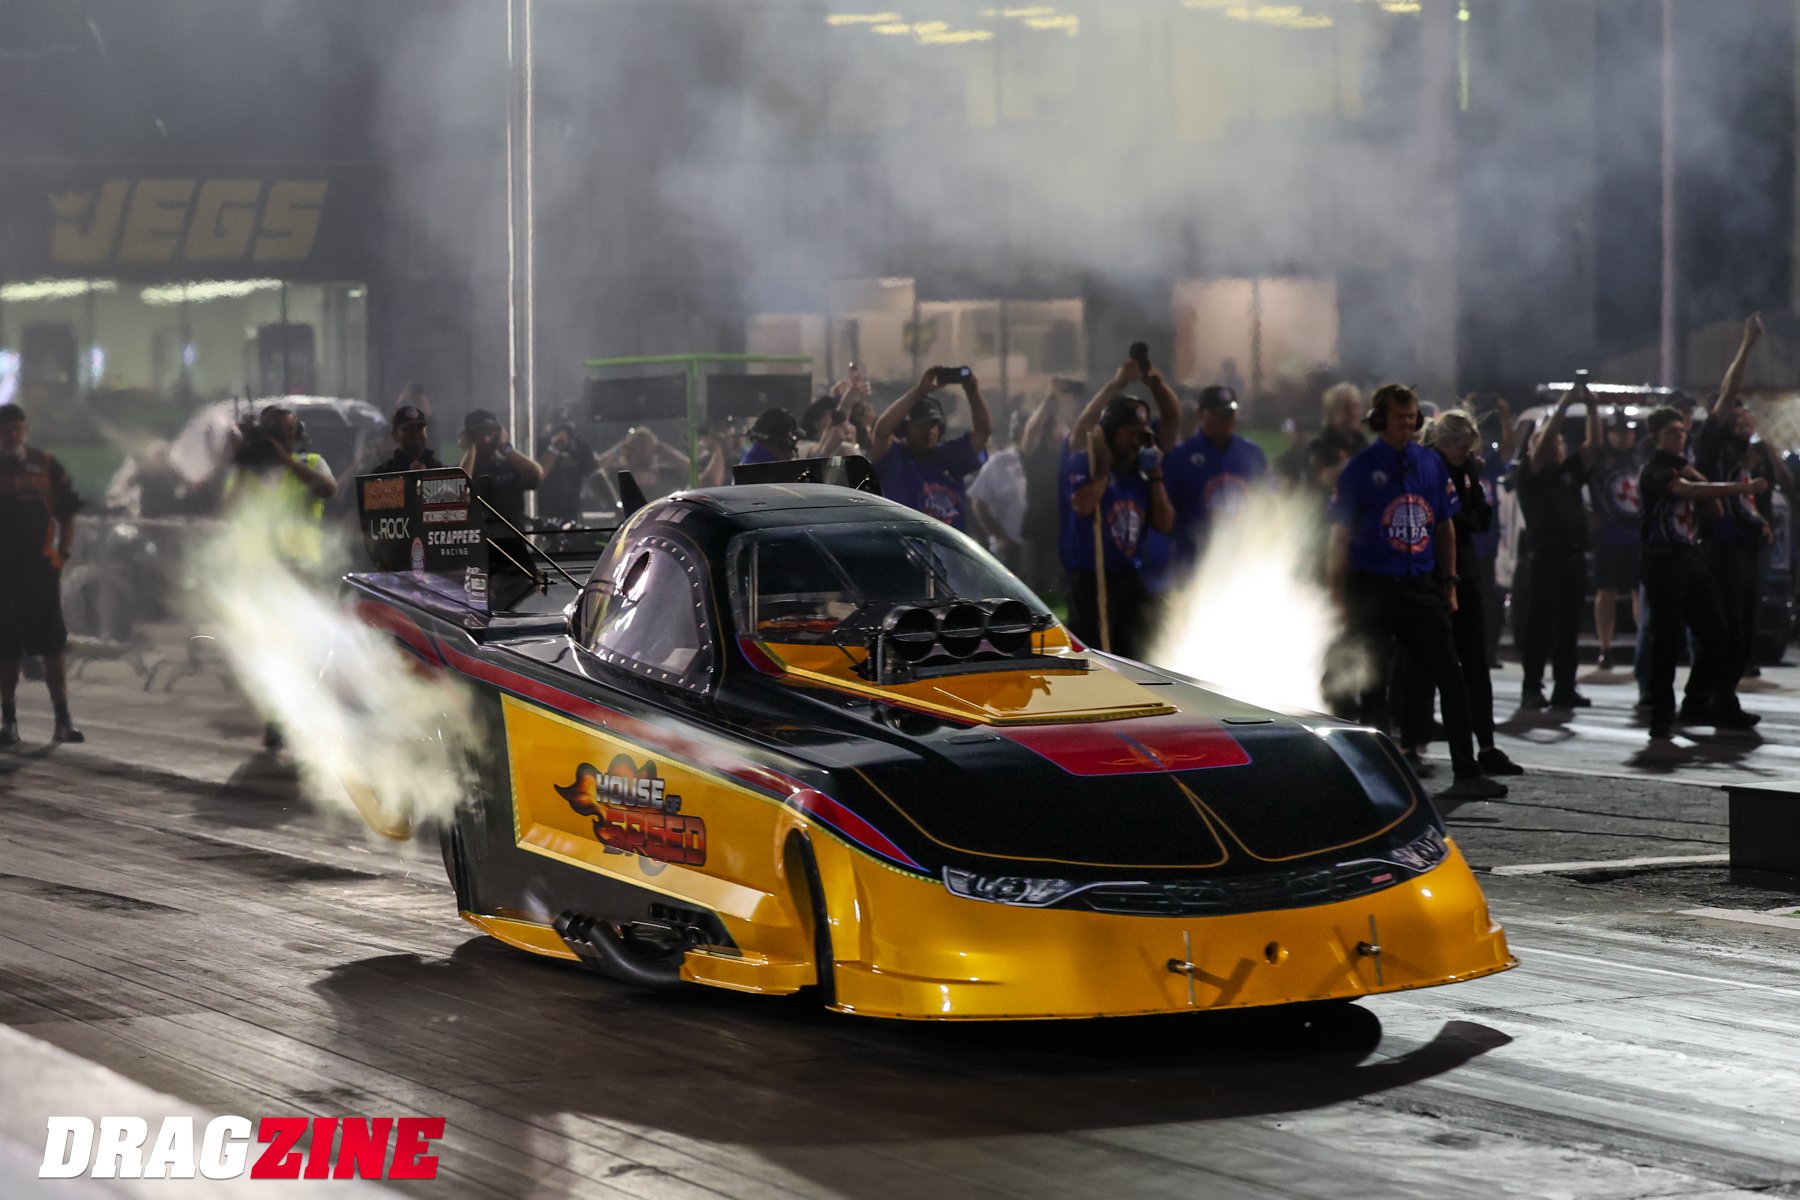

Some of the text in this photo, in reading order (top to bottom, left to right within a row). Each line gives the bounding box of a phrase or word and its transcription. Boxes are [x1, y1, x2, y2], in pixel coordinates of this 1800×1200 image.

[49, 178, 329, 262] JEGS
[428, 529, 481, 545] SCRAPPERS
[1388, 526, 1429, 539] IHRA
[441, 548, 469, 556] RACING
[595, 773, 665, 810] HOUSE
